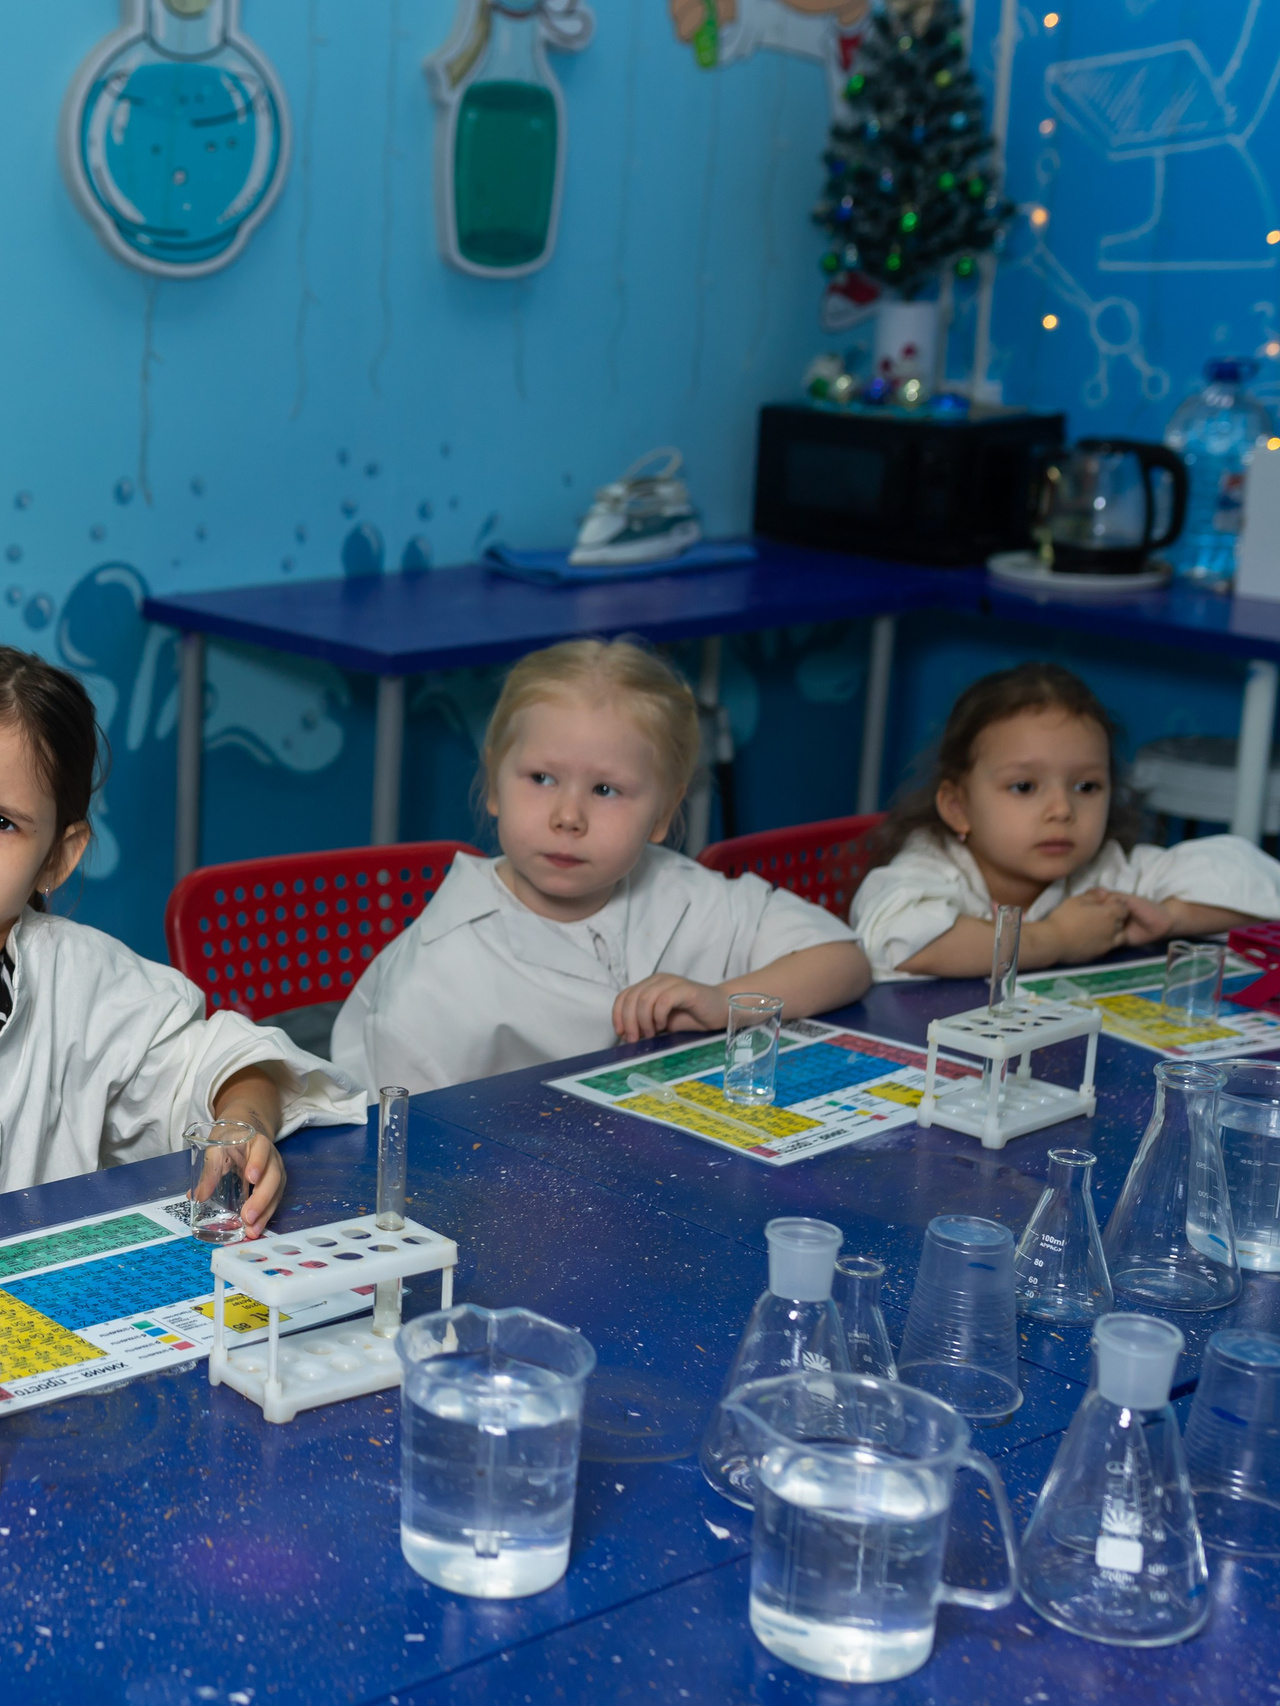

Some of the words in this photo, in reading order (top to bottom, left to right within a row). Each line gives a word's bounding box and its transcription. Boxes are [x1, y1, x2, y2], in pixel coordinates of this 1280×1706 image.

[1041, 1234, 1064, 1246] 100ml
[1033, 1258, 1044, 1267] 80
[1028, 1276, 1038, 1284] 60
[1025, 1290, 1034, 1298] 40
[81, 1362, 128, 1378] химия
[14, 1379, 67, 1396] просто
